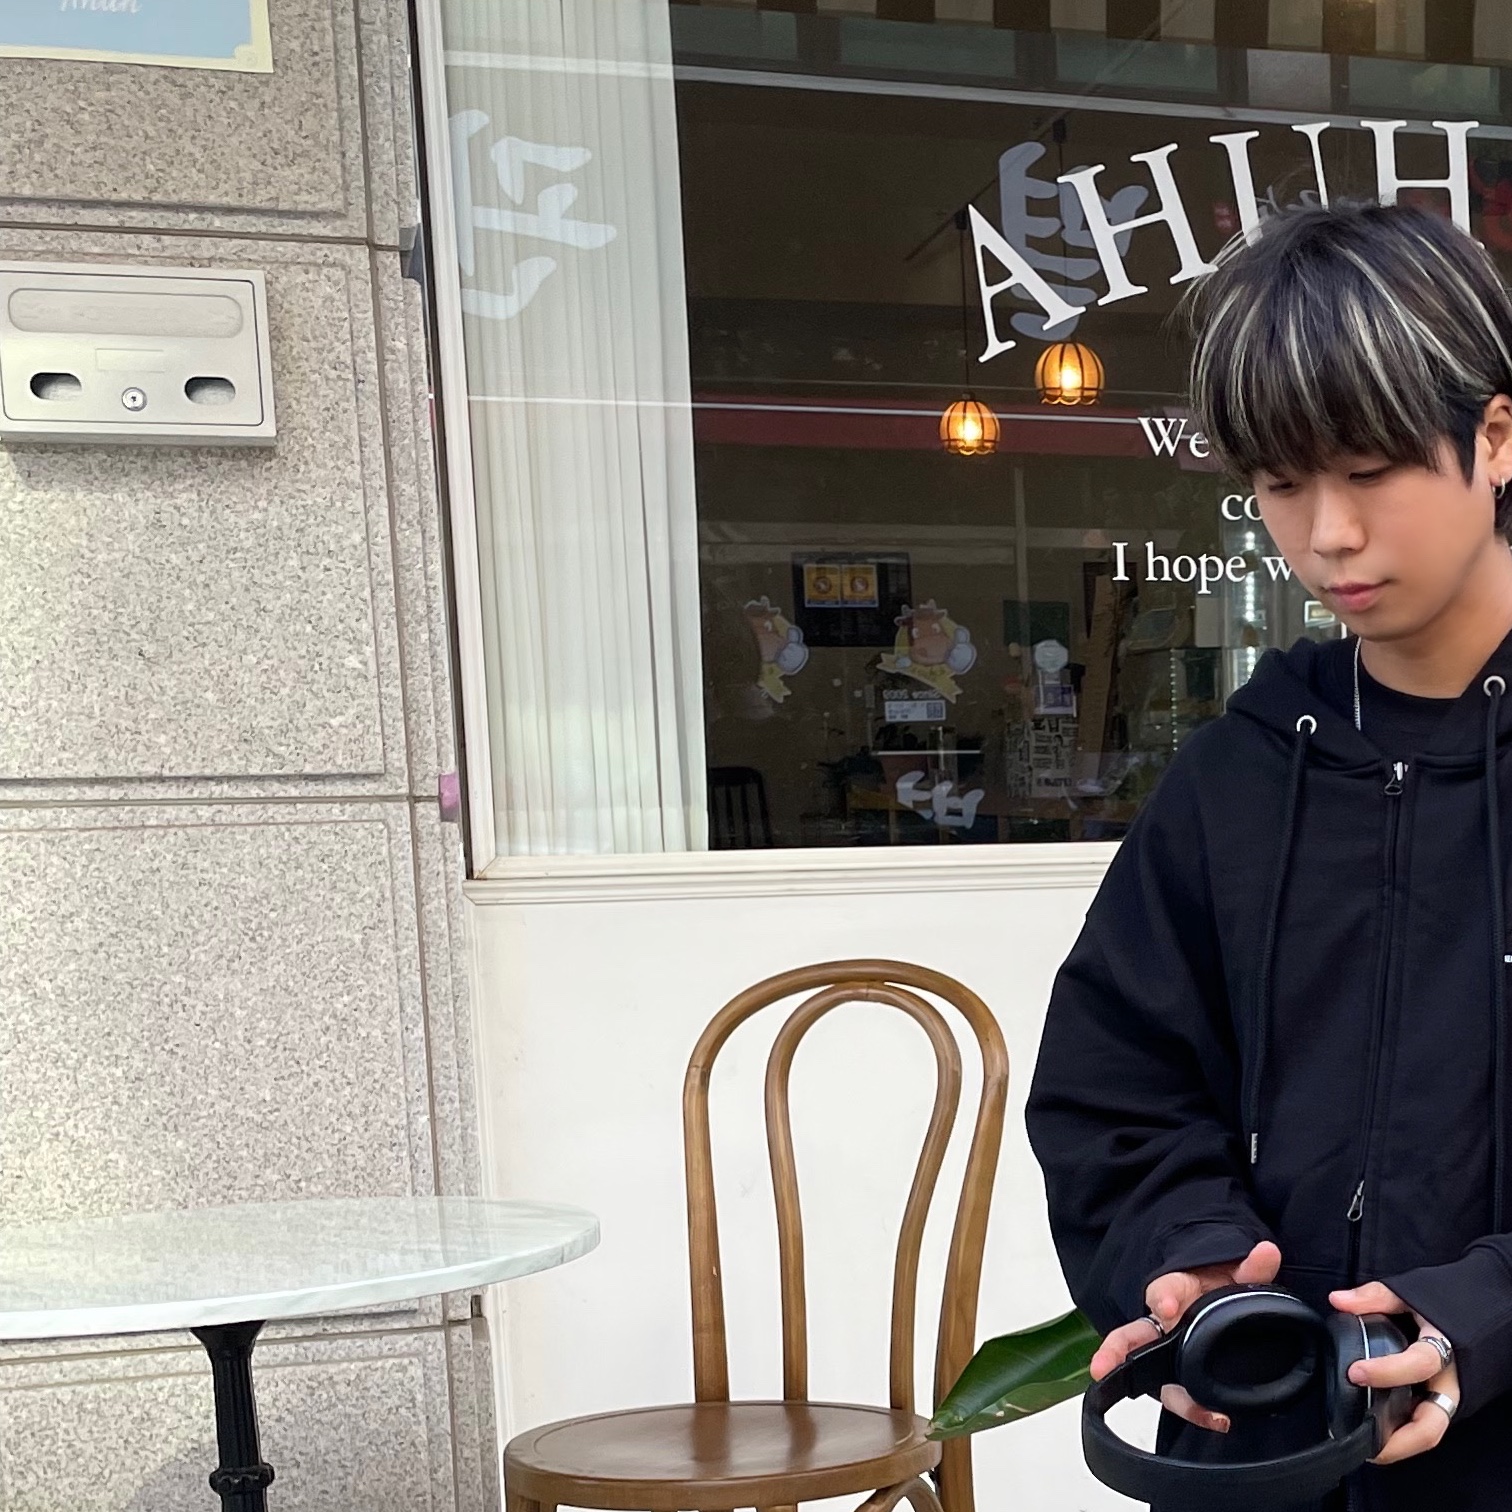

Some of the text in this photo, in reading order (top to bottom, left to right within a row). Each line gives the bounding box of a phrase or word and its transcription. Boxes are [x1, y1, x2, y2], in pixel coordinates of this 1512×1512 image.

[1137, 416, 1210, 458] We
[1111, 541, 1131, 582] I
[1144, 540, 1247, 595] hope
[1261, 555, 1293, 582] w
